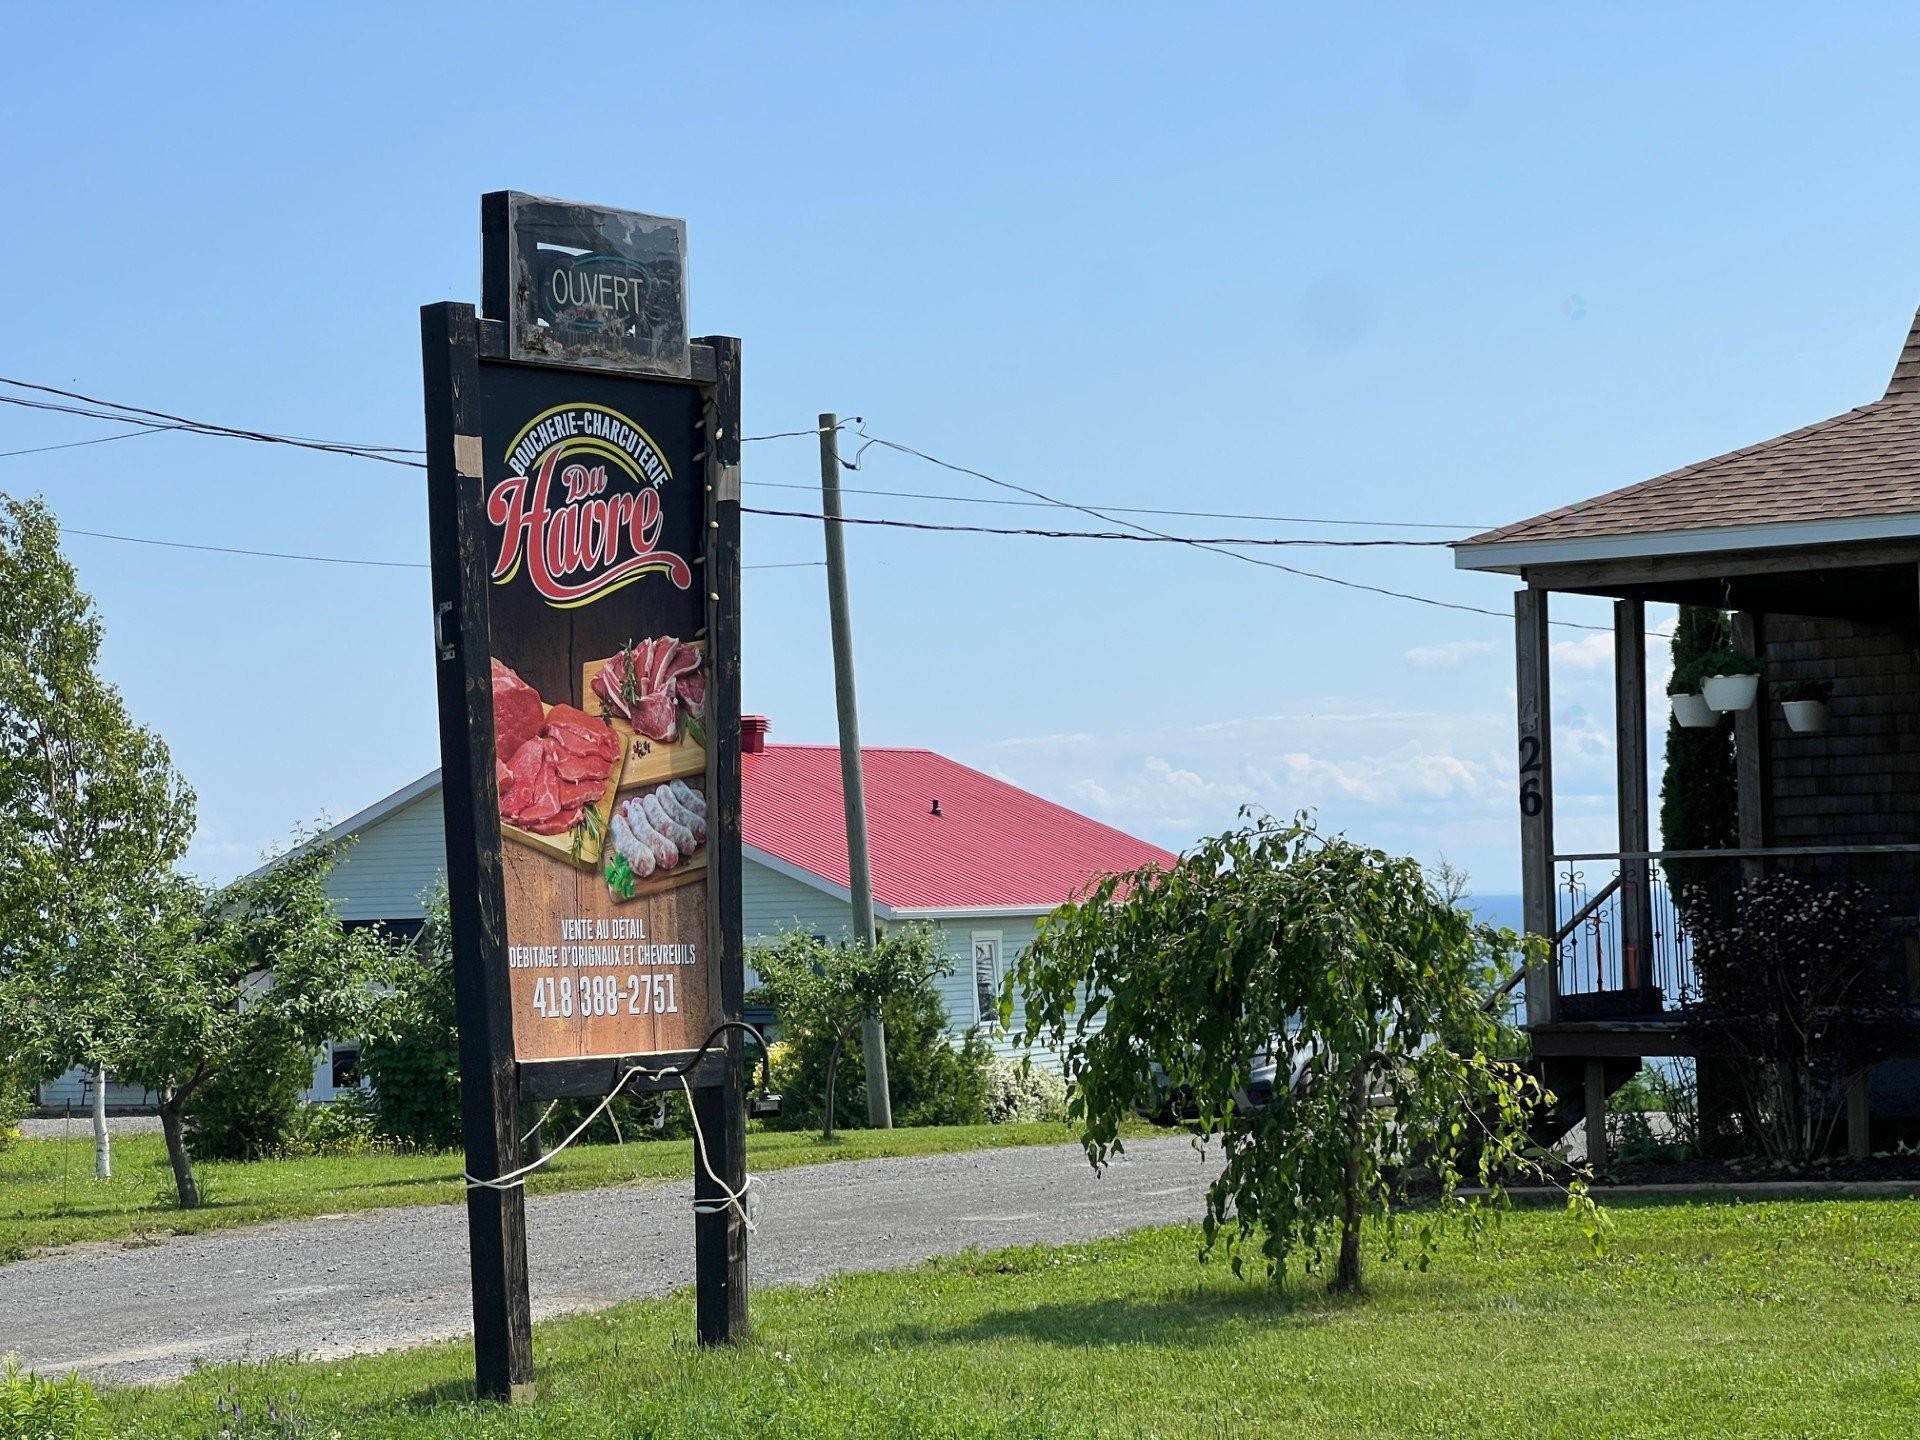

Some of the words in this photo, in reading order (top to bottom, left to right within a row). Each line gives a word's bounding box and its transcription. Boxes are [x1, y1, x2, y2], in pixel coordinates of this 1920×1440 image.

[552, 269, 643, 314] OUVERT
[508, 411, 669, 490] BOUCHERIE-CHARCUTERIE
[561, 464, 608, 504] Du
[487, 445, 691, 600] Havre
[562, 919, 594, 941] VENTE
[597, 919, 610, 940] AU
[612, 916, 646, 940] DÉTAIL
[509, 944, 559, 968] DÉBITAGE
[562, 945, 622, 967] D'ORIGNAUX
[624, 945, 637, 966] ET
[638, 944, 697, 966] CHEVREUILS
[533, 976, 574, 1018] 418
[580, 973, 678, 1017] 388-2751
